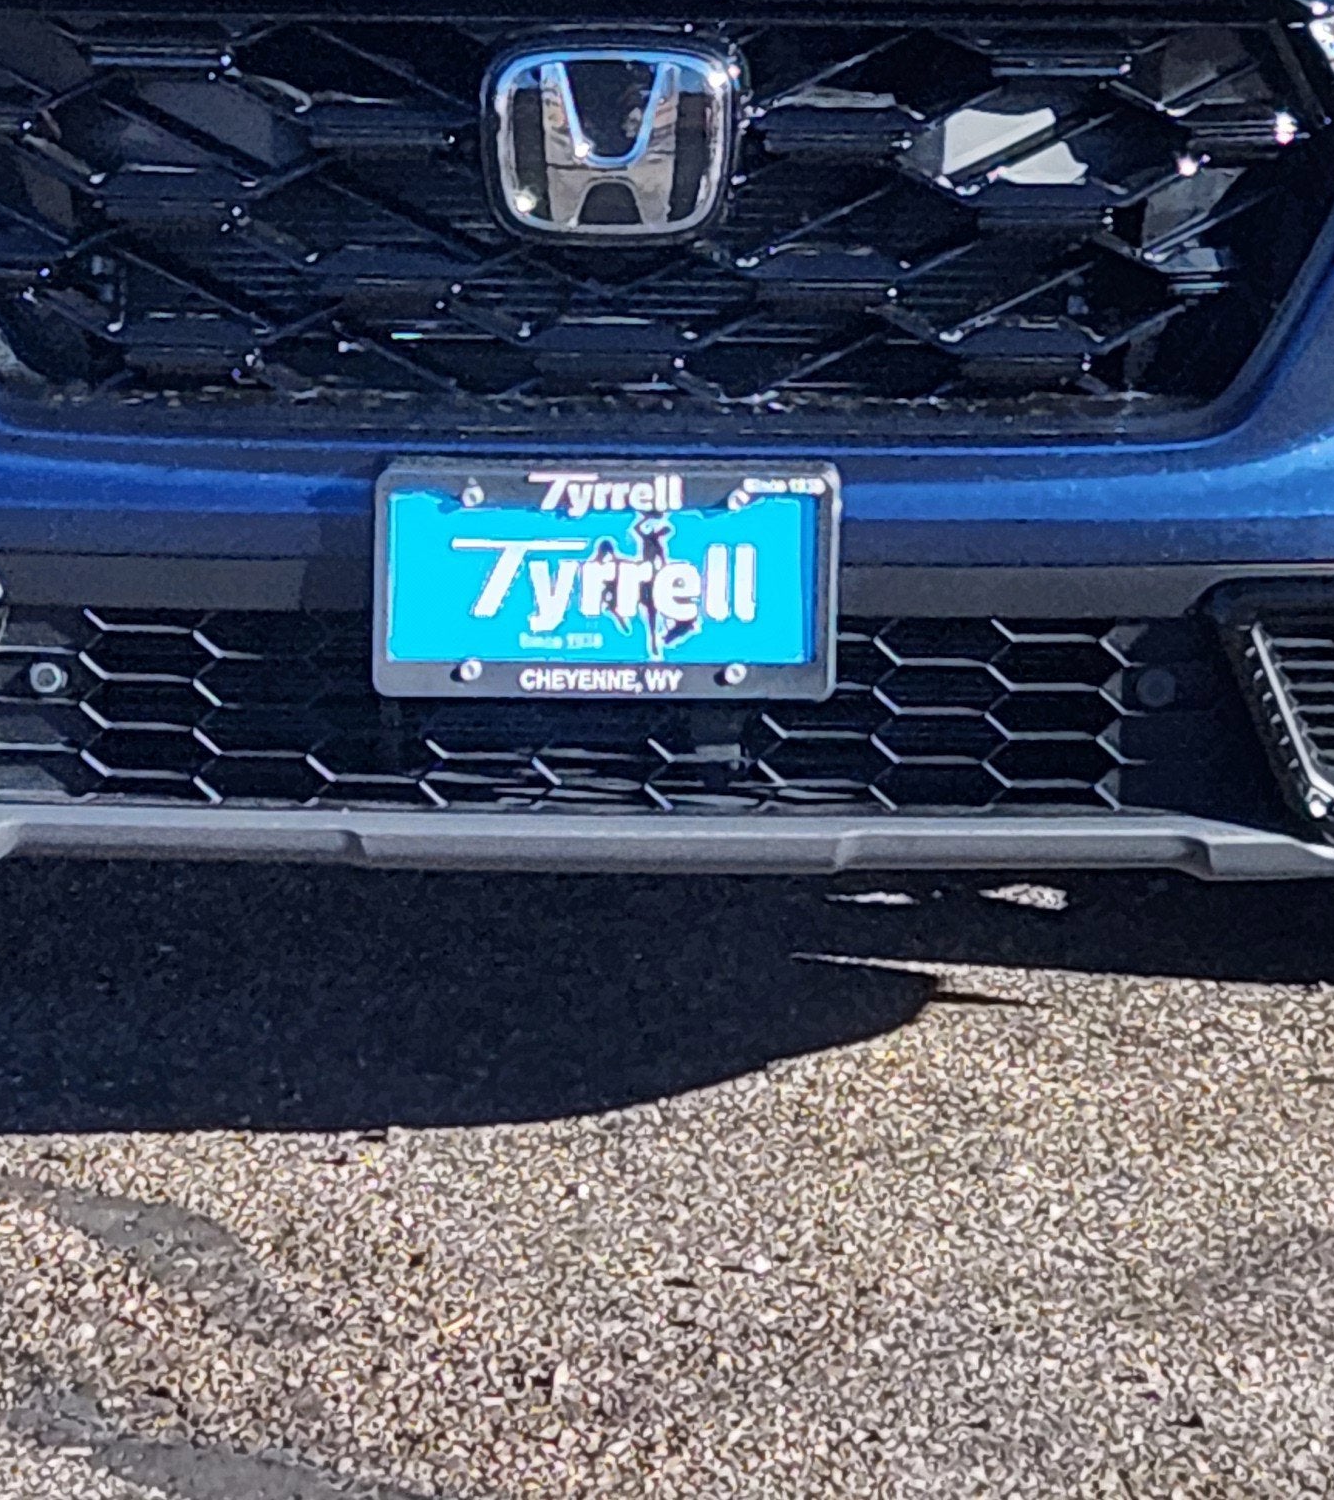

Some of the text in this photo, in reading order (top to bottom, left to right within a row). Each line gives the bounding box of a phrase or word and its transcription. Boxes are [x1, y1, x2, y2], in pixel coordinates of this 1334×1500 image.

[528, 472, 683, 518] Tyrrell
[451, 538, 757, 632] Tyrrell
[519, 668, 684, 695] CHEYENNE, WY
